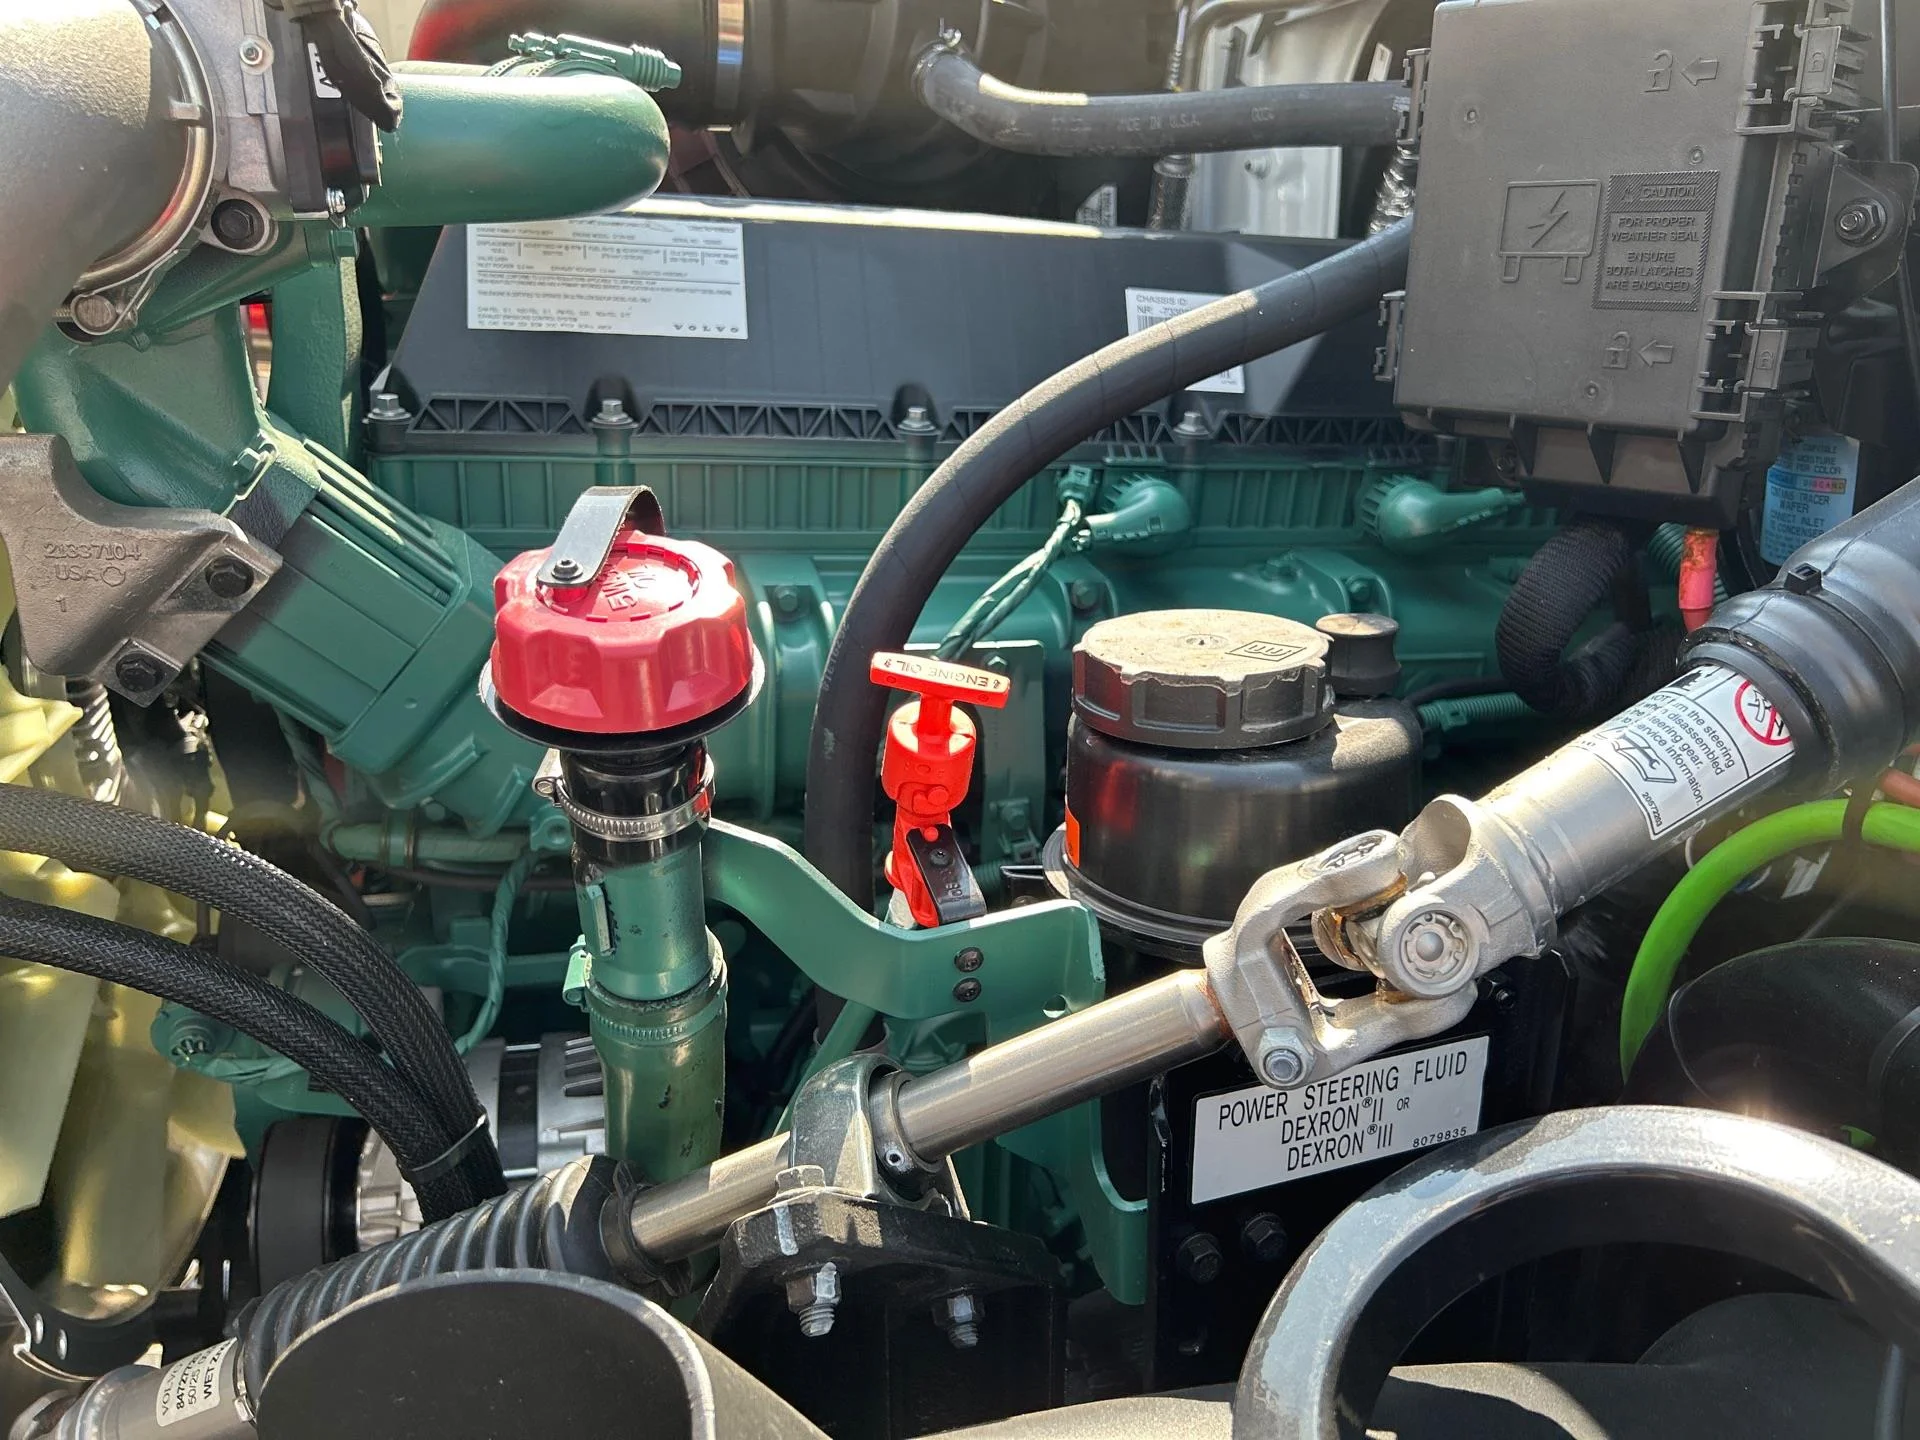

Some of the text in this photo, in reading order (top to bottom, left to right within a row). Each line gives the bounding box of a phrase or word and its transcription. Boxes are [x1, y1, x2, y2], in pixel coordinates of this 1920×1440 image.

[1642, 187, 1697, 199] CAUTION
[1618, 216, 1697, 228] FOR PROPER
[1610, 231, 1700, 243] WEATHER SEAL
[1627, 252, 1676, 263] ENSURE
[1605, 266, 1695, 277] BOTH LATCHES
[1605, 281, 1691, 292] ARE ENGAGED
[673, 323, 740, 334] VOLVO
[897, 660, 988, 687] ENGINE OIL
[1667, 712, 1726, 777] disassembled
[1687, 710, 1706, 727] the
[1703, 725, 1736, 769] steering
[1679, 742, 1705, 770] gear.
[1664, 744, 1705, 807] information.
[1219, 1050, 1467, 1131] POWER STEERING FLUID
[1396, 1097, 1411, 1112] OR
[1412, 1126, 1468, 1149] 8079835
[203, 1367, 215, 1400] WET
